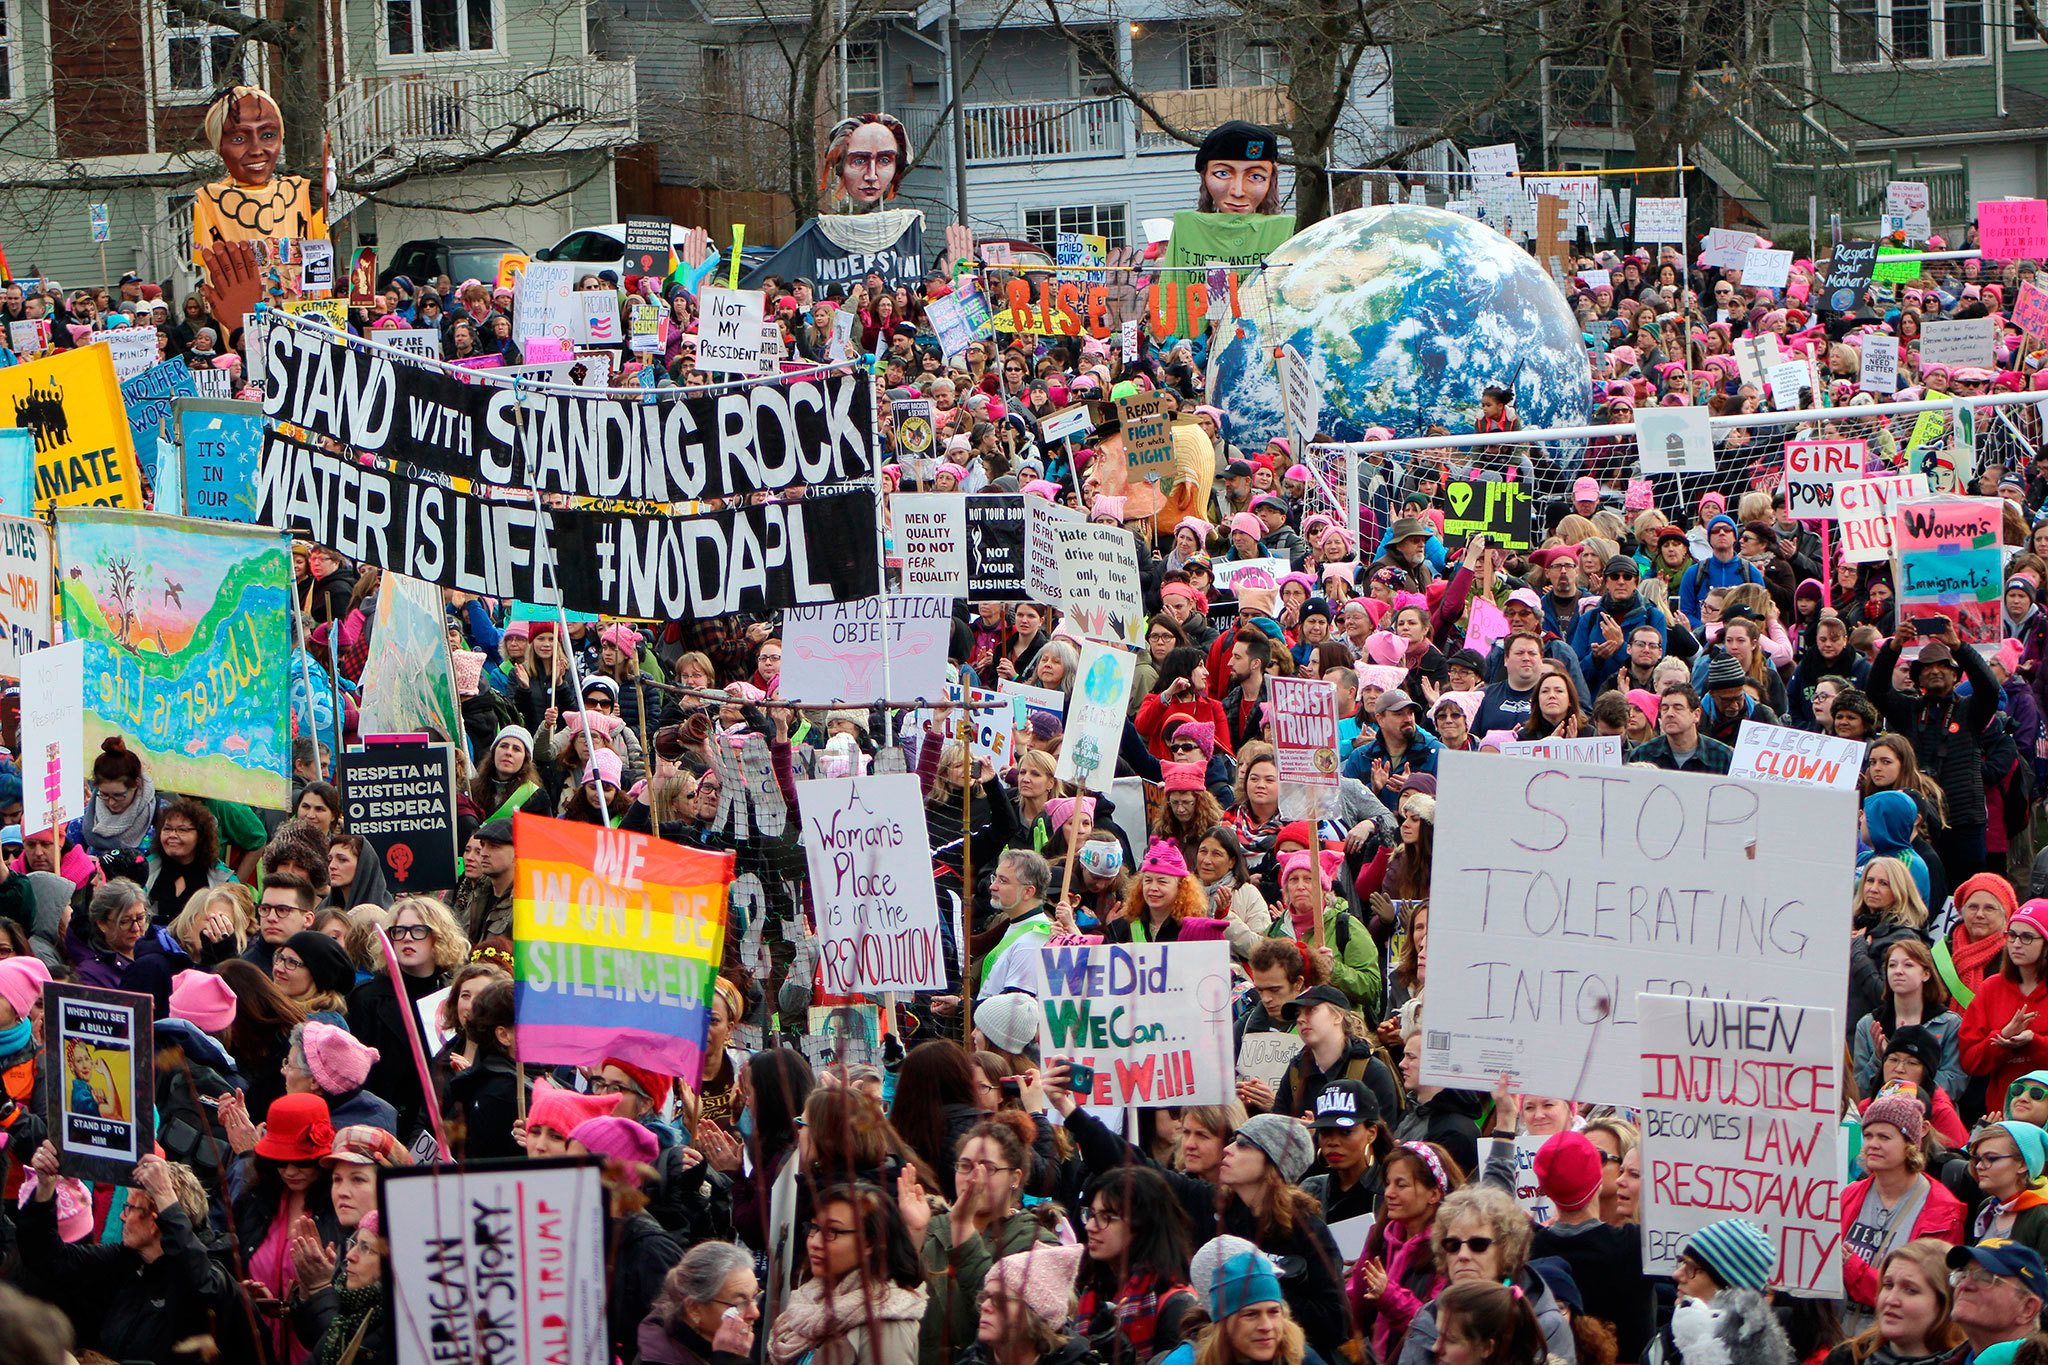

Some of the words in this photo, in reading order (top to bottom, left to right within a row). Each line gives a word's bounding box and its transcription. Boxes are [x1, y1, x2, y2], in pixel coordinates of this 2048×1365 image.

[628, 220, 660, 229] RESPETA
[661, 221, 670, 229] MI
[628, 228, 669, 237] EXISTENCIA
[636, 236, 669, 245] ESPERA
[1058, 233, 1079, 242] THEY
[627, 244, 669, 252] RESISTENCIA
[1058, 242, 1083, 253] TRIED
[1086, 244, 1098, 253] TO
[1835, 243, 1876, 263] Respect
[1058, 253, 1082, 265] BURY
[1093, 256, 1106, 267] US
[1747, 252, 1791, 269] RESIST
[526, 266, 568, 281] WOMAN'S
[1837, 262, 1861, 276] your
[524, 278, 555, 291] RIGHTS
[1825, 274, 1864, 288] Mother
[523, 290, 543, 304] ARE
[584, 296, 617, 314] PRESIDENT
[522, 307, 556, 319] HUMAN
[639, 307, 659, 320] FIGHT
[712, 296, 746, 317] NOT
[1007, 278, 1110, 338] RISE
[718, 321, 740, 340] MY
[388, 338, 403, 347] WE
[406, 337, 423, 346] ARE
[530, 345, 554, 355] MAKE
[700, 340, 759, 361] PRESIDENT
[1865, 365, 1894, 373] BETTER
[263, 324, 397, 450] STAND
[408, 395, 473, 457] WITH
[480, 391, 707, 502] STANDING
[717, 375, 872, 496] ROCK
[1126, 401, 1160, 419] READY
[1128, 422, 1163, 441] FIGHT
[198, 441, 225, 457] IT'S
[1128, 445, 1171, 467] RIGHT
[203, 466, 223, 481] IN
[197, 489, 228, 507] OUR
[905, 513, 931, 524] MEN
[933, 513, 947, 524] OF
[969, 508, 982, 521] NOT
[984, 507, 1005, 520] YOUR
[1007, 507, 1025, 520] BODY
[1033, 508, 1046, 522] NO
[255, 437, 391, 572] WATER
[404, 483, 445, 583] IS
[455, 495, 563, 604] LIFE
[597, 504, 835, 618] #NODAPL
[906, 528, 950, 539] QUALITY
[1033, 522, 1041, 534] IS
[1032, 537, 1054, 554] WHEN
[1093, 530, 1124, 546] cannot
[907, 542, 927, 553] DO
[929, 542, 955, 553] NOT
[986, 548, 1009, 558] NOT
[1065, 548, 1094, 561] drive
[1098, 549, 1114, 562] out
[908, 557, 936, 568] FEAR
[981, 563, 1014, 573] YOUR
[909, 571, 960, 582] EQUALITY
[1031, 565, 1045, 579] ARE
[1076, 569, 1099, 585] only
[1108, 570, 1127, 584] love
[1219, 566, 1275, 583] WOMEN'S
[1903, 563, 1991, 593] Immigrants'
[969, 580, 1026, 590] BUSINESS
[1069, 587, 1090, 598] can
[1098, 587, 1111, 600] do
[788, 604, 824, 622] NOT
[834, 602, 847, 620] A
[1275, 681, 1330, 715] RESIST
[1277, 712, 1333, 746] TRUMP
[1745, 726, 1832, 757] ELECT
[1840, 744, 1859, 765] A
[346, 765, 420, 781] RESPETA
[423, 763, 442, 777] MI
[1754, 750, 1841, 784] CLOWN
[348, 781, 444, 799] EXISTENCIA
[847, 780, 872, 814] A
[349, 803, 365, 818] O
[369, 798, 445, 818] ESPERA
[1510, 769, 1759, 861] STOP
[350, 817, 447, 835] RESISTENCIA
[814, 810, 904, 850] Woman's
[593, 830, 648, 889] WE
[833, 851, 896, 898] Place
[671, 891, 713, 948] BE
[828, 903, 842, 926] is
[852, 900, 871, 928] in
[877, 895, 908, 928] the
[1461, 867, 1809, 956] TOLERATING
[822, 924, 939, 993] REVOLUTION
[66, 1006, 90, 1019] WHEN
[91, 1008, 109, 1021] YOU
[110, 1011, 126, 1024] SEE
[79, 1022, 86, 1031] A
[87, 1023, 113, 1035] BULLY
[1686, 1001, 1805, 1054] WHEN
[1238, 1040, 1265, 1067] NO
[1114, 1050, 1196, 1104] Will!
[1640, 1053, 1835, 1115] INJUSTICE
[73, 1118, 99, 1131] STAND
[100, 1121, 112, 1133] UP
[113, 1124, 125, 1135] TO
[91, 1135, 107, 1146] HIM
[1646, 1109, 1741, 1140] BECOMES
[1744, 1115, 1824, 1168] LAW
[1653, 1160, 1842, 1223] RESISTANCE
[473, 1197, 516, 1301] STORY
[537, 1199, 564, 1303] TRUMP
